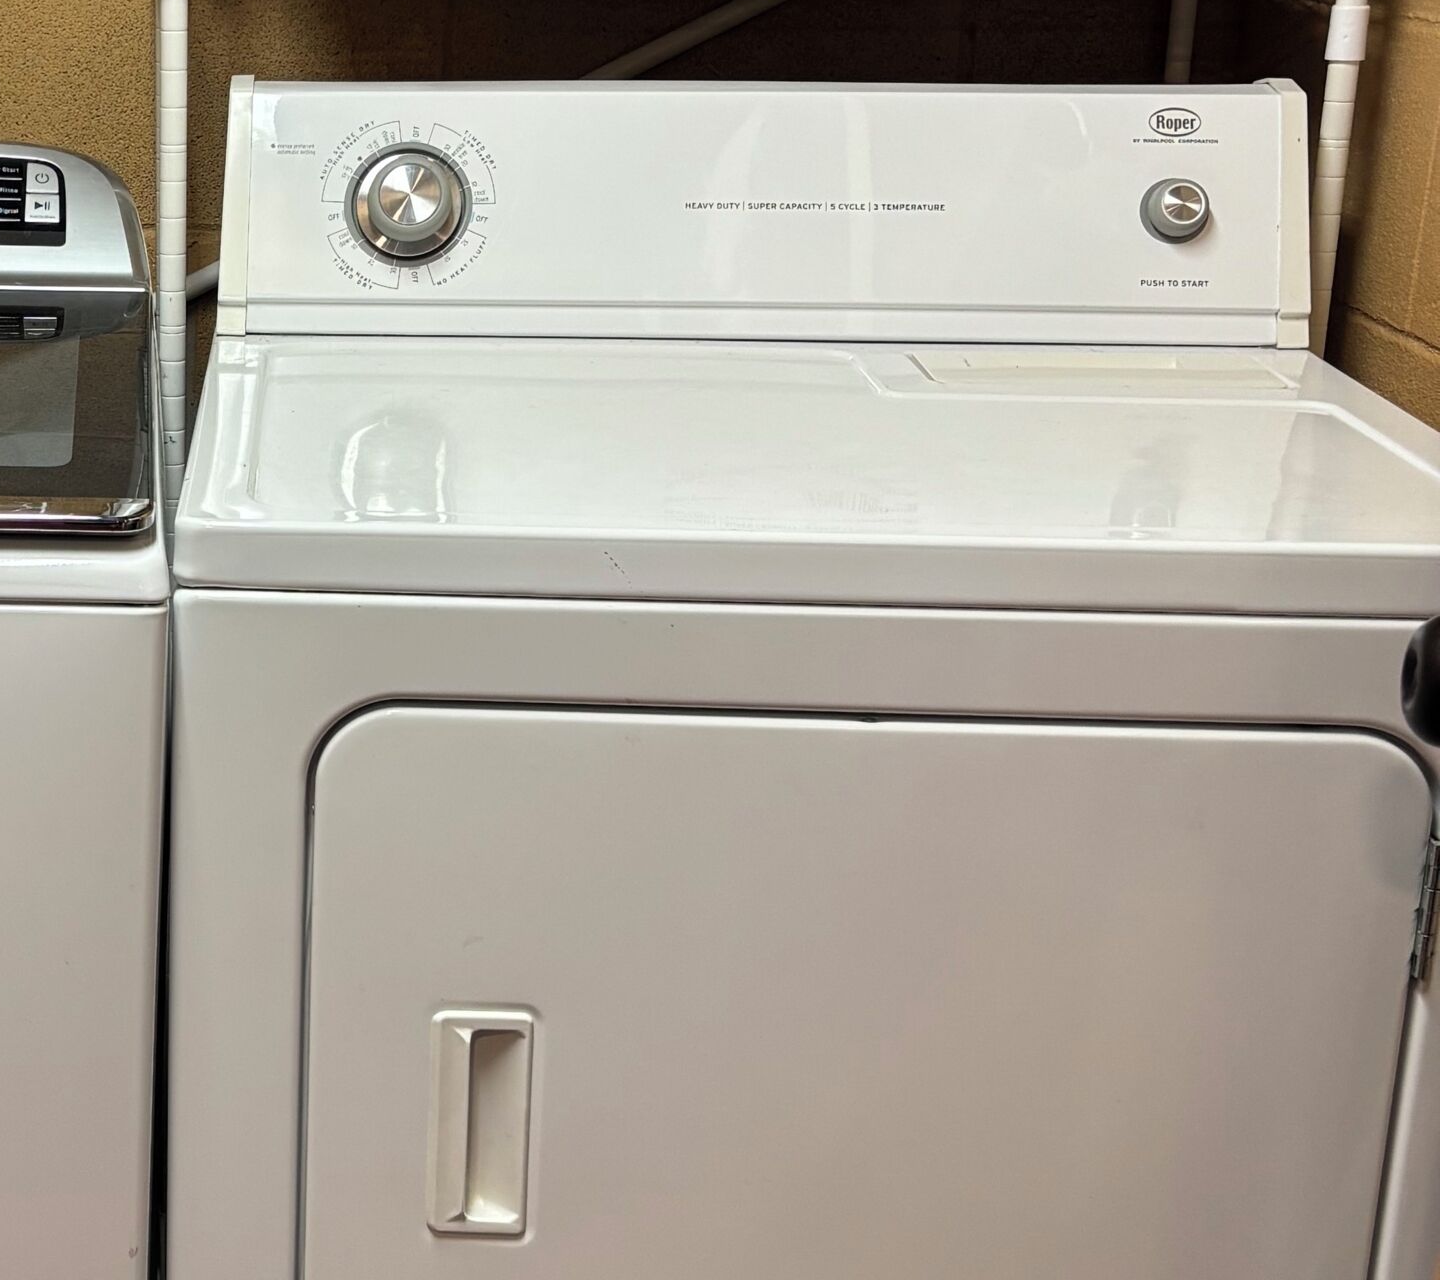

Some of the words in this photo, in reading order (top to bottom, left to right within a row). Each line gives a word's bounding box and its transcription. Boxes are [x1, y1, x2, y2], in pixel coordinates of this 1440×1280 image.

[1155, 115, 1196, 132] Roper
[685, 202, 714, 210] HEAVY
[717, 202, 741, 210] DUTY
[838, 203, 866, 211] CYCLE
[882, 203, 946, 211] TEMPERATURE
[1140, 279, 1164, 287] PUSH
